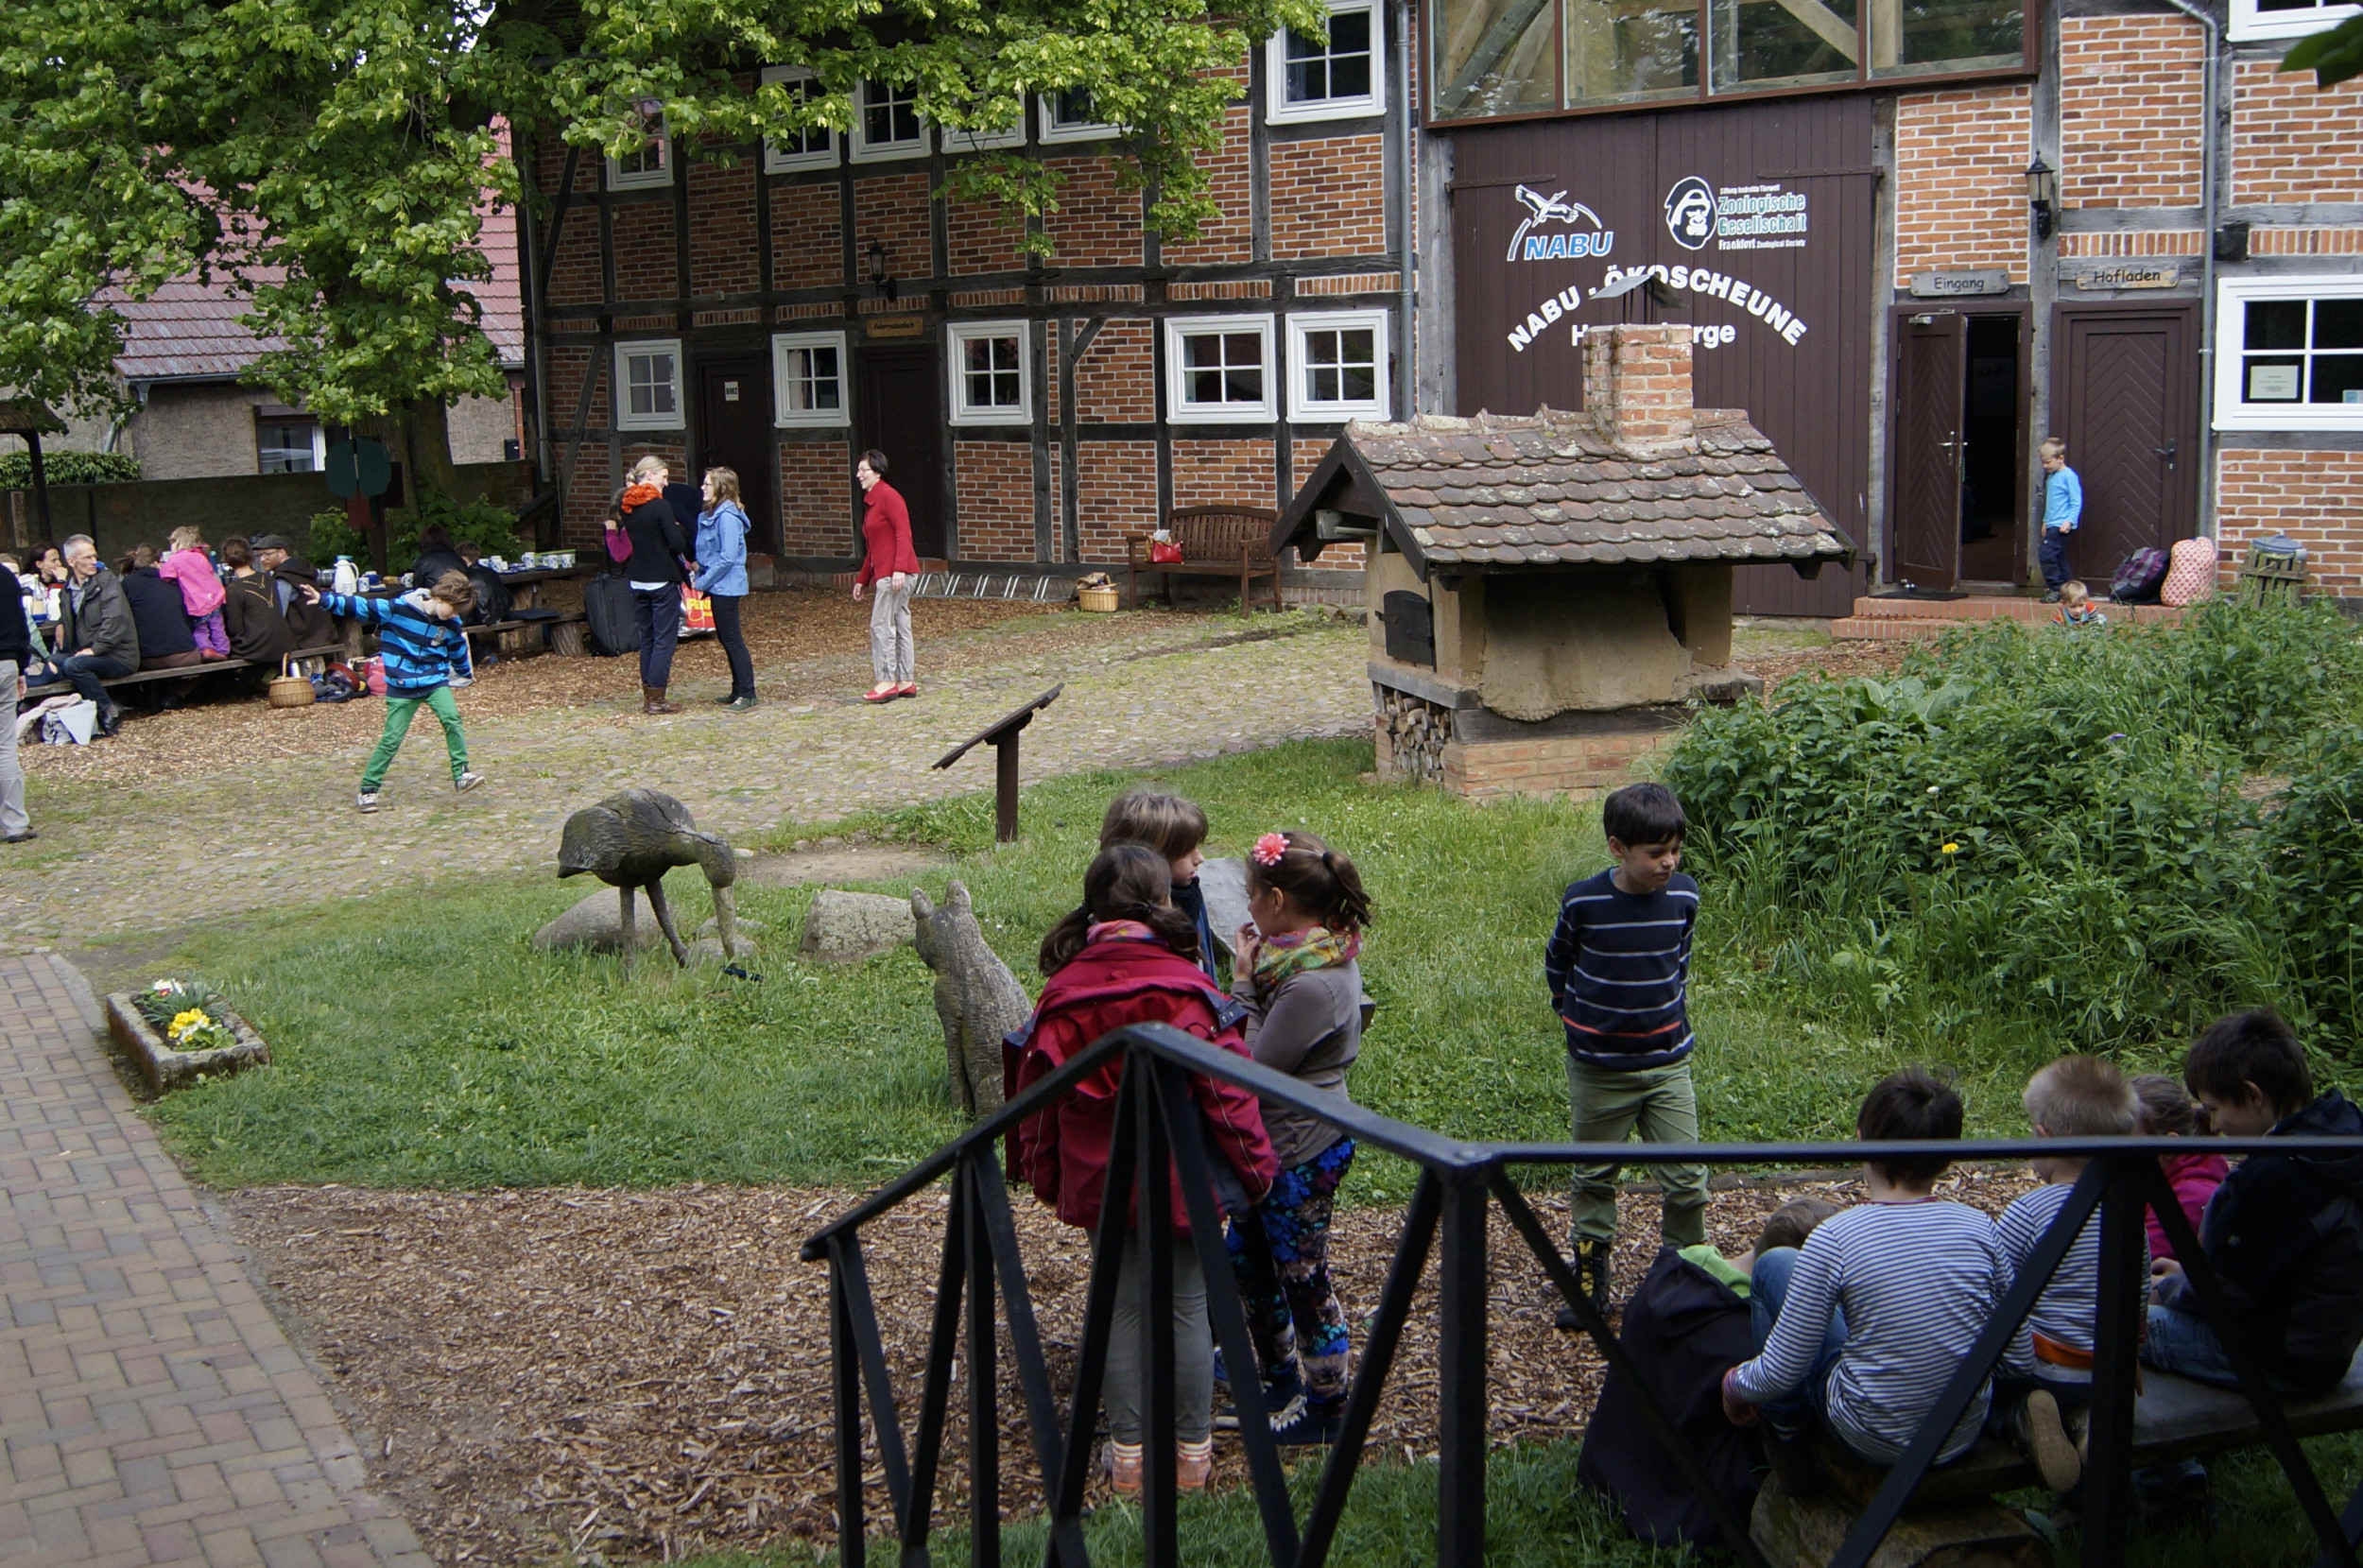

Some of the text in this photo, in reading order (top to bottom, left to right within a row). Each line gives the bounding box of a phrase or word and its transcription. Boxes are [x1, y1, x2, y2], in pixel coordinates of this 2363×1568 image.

[1717, 192, 1806, 215] Zoologische
[1717, 213, 1807, 236] Gesellschaft
[1524, 231, 1613, 261] NABU
[1718, 238, 1756, 250] Frankfurt
[1934, 276, 1984, 292] Eingang
[2093, 267, 2161, 284] Hofladen
[1508, 285, 1580, 353] NABU
